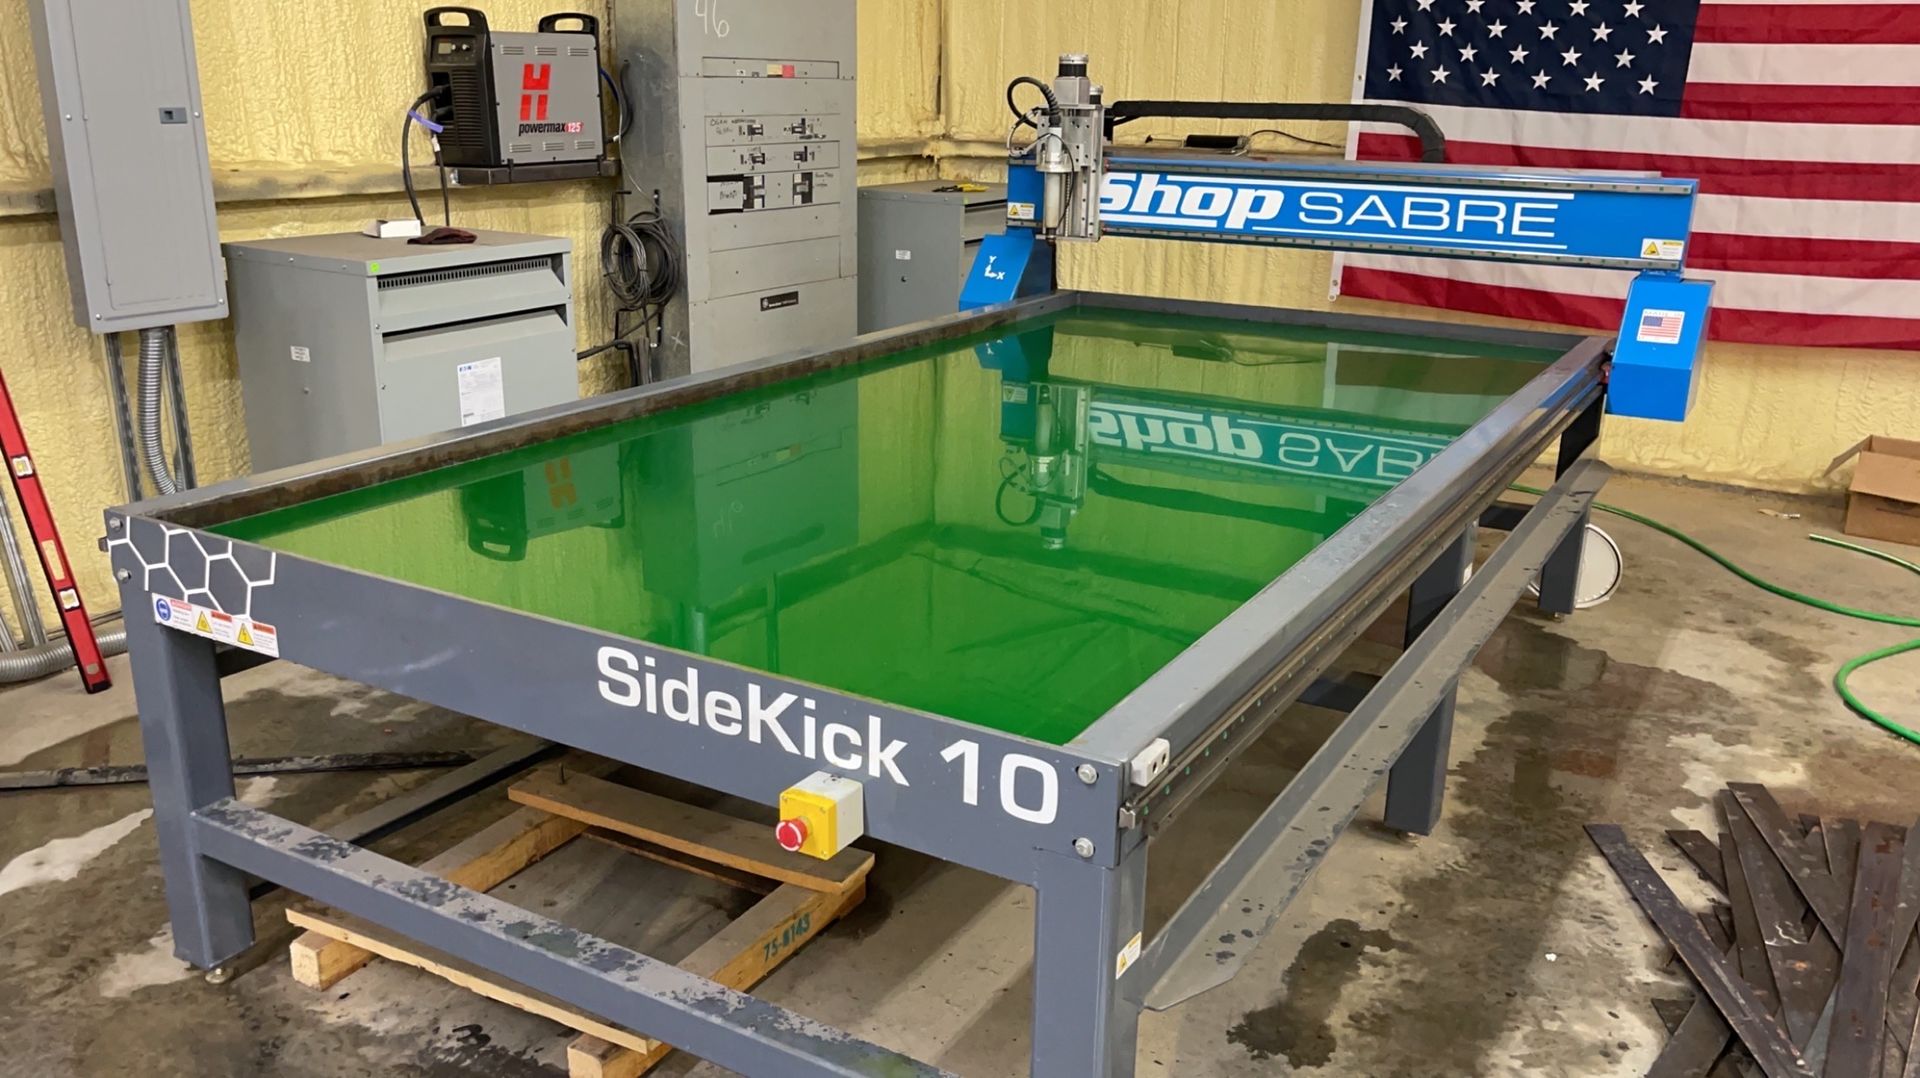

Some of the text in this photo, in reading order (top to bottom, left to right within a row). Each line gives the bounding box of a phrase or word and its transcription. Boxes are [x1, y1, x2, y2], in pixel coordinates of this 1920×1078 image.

[695, 0, 730, 38] 46
[518, 121, 582, 137] powermax 125
[1100, 172, 1559, 238] Shop SABRE
[597, 645, 1059, 826] SideKick 10
